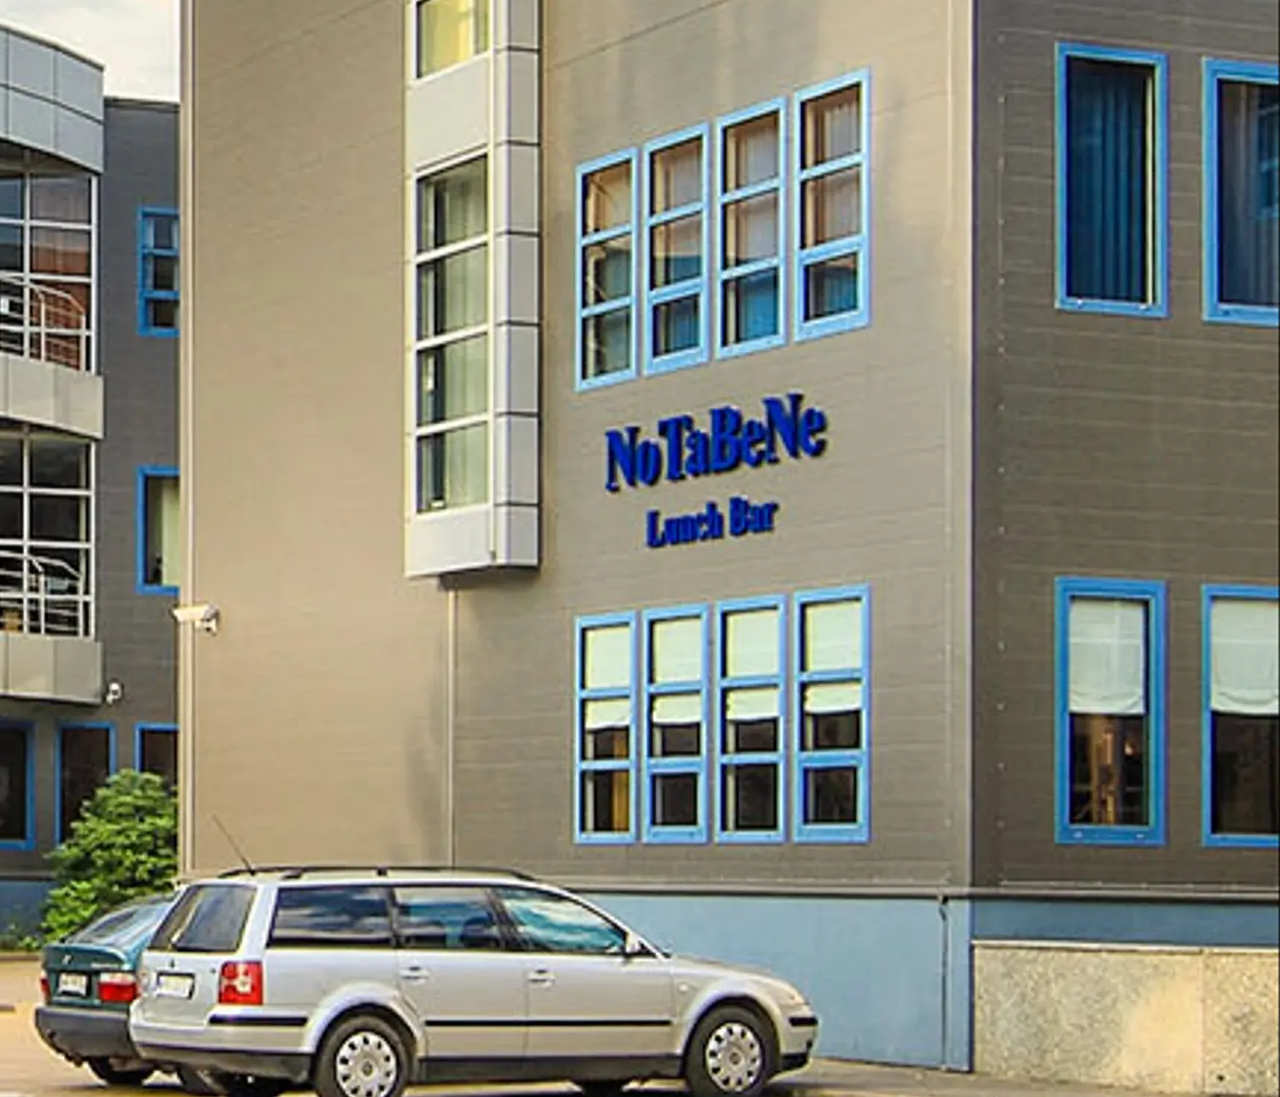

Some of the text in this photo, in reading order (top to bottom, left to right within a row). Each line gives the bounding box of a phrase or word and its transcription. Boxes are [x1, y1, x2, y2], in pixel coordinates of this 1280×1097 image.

[605, 391, 828, 493] NoTaBeNe
[646, 496, 779, 548] Lunch Bar
